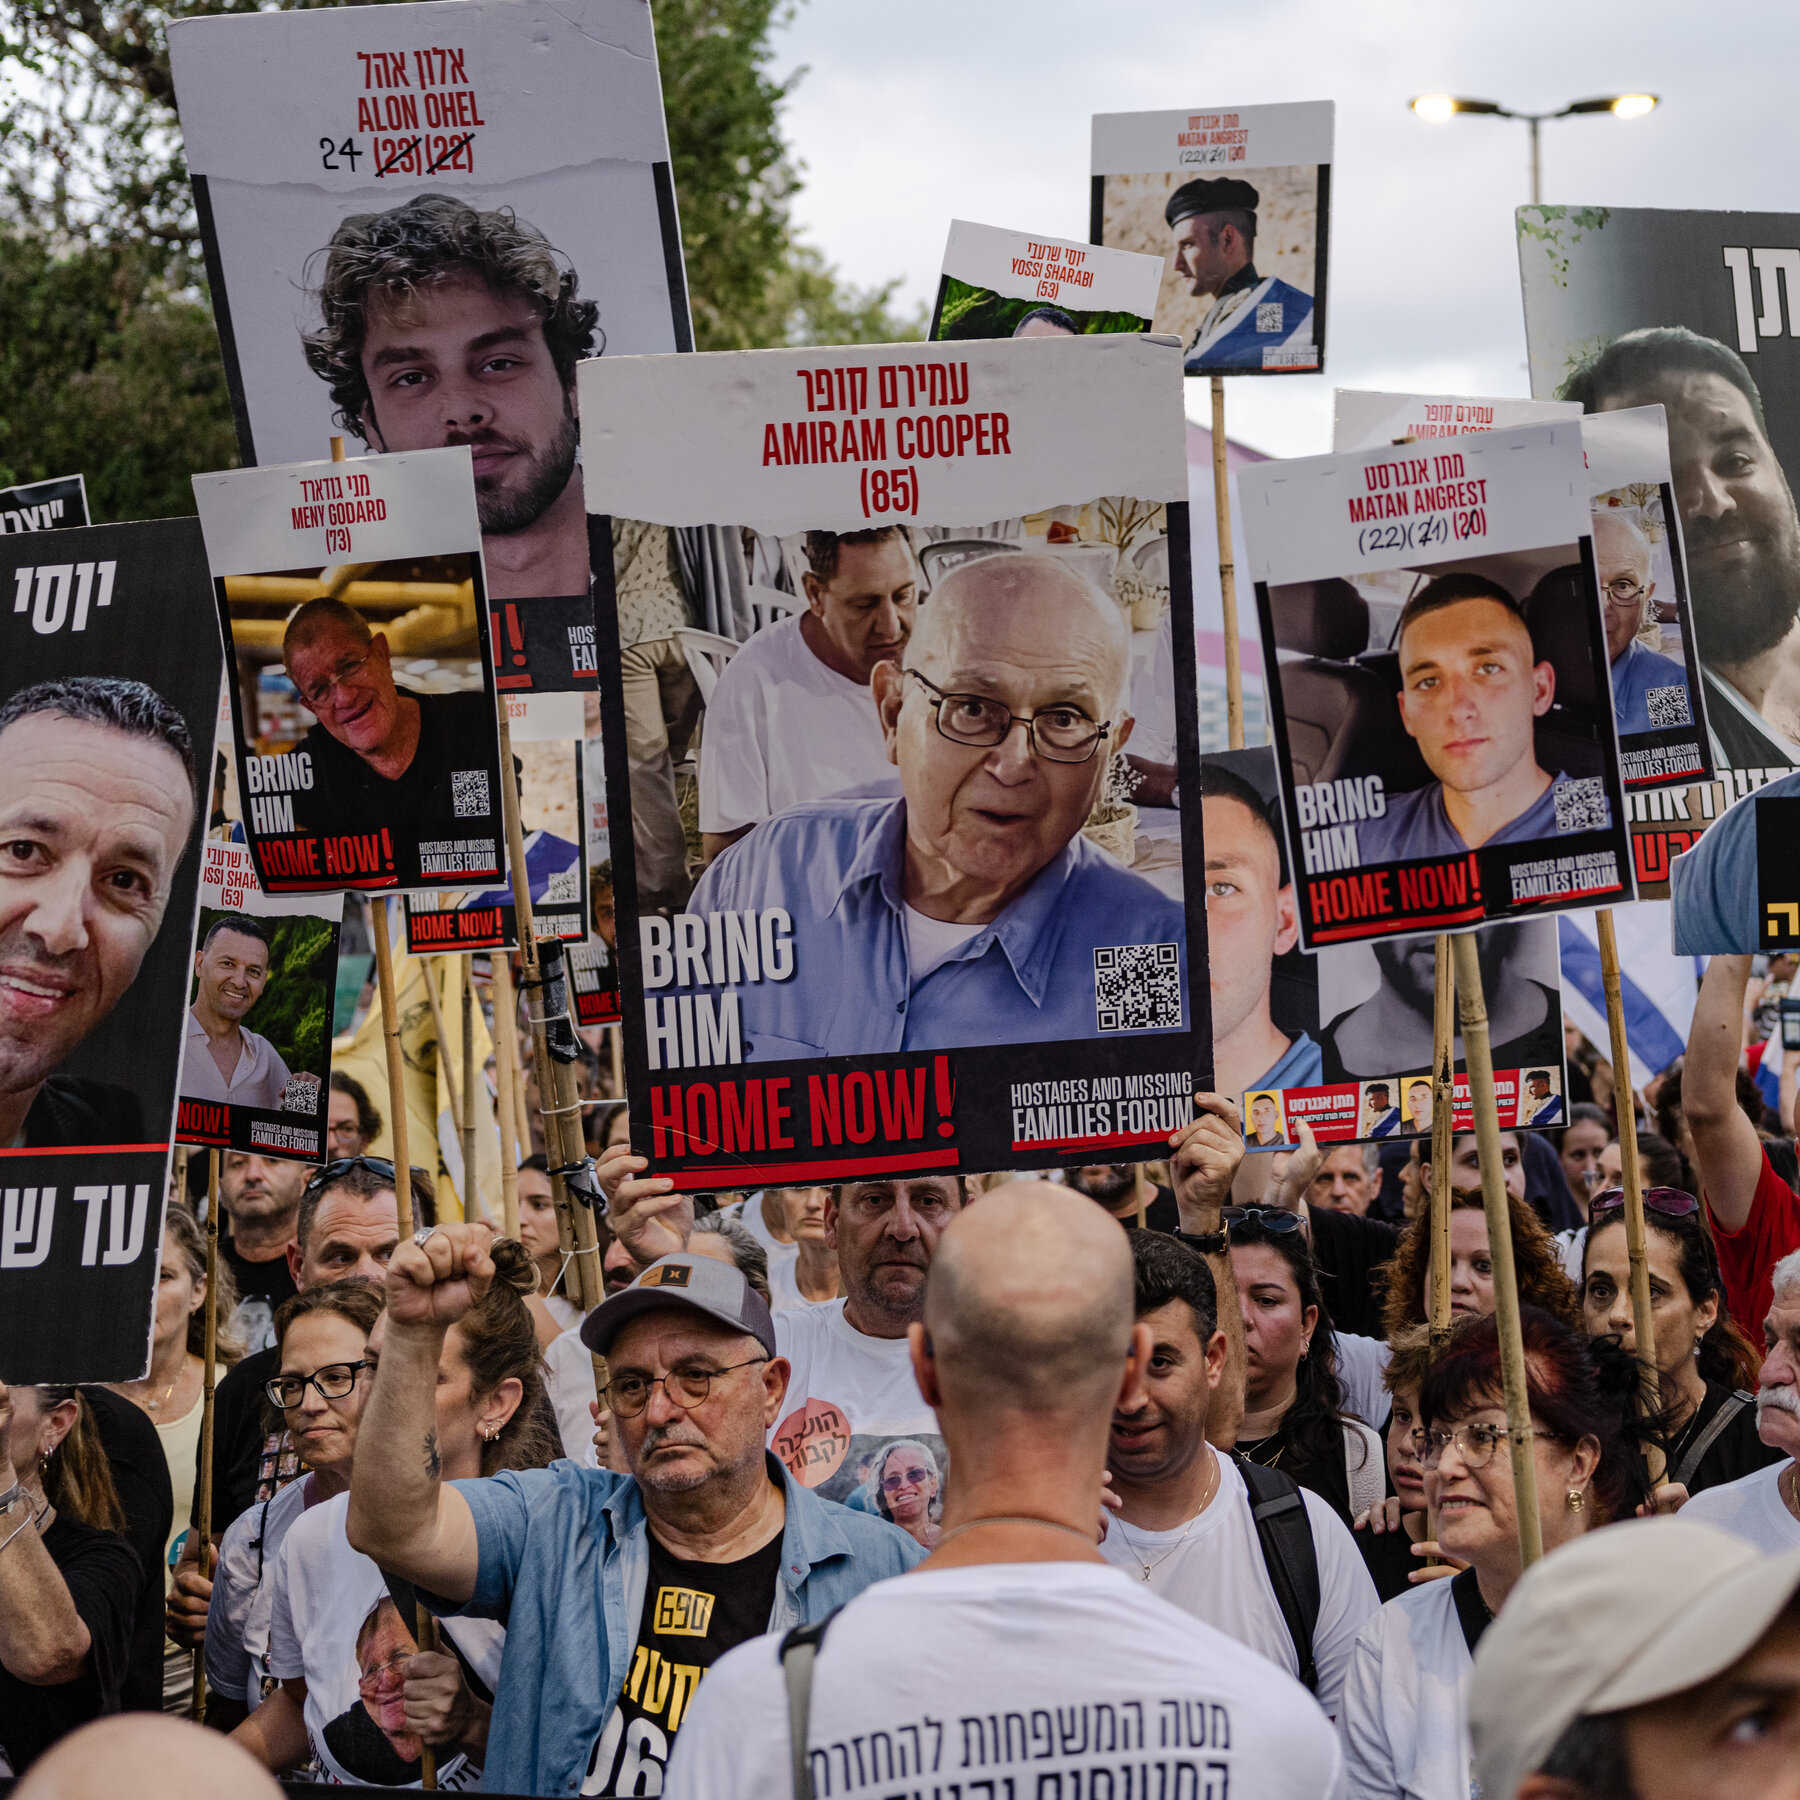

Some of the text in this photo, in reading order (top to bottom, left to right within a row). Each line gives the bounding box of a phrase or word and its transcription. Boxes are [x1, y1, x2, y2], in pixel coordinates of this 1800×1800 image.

[357, 47, 469, 90] אלון אהל
[358, 91, 485, 132] ALON OHEL
[319, 137, 363, 173] 24
[1178, 129, 1248, 147] MATAN ANGREST
[1028, 242, 1086, 267] יוסי שרעבי
[1011, 258, 1094, 288] YOSSI SHARABI
[1036, 280, 1060, 300] (53)
[797, 362, 969, 415] עמירם קופר
[1424, 404, 1493, 424] עמירם קופר
[762, 412, 1012, 467] AMIRAM COOPER
[300, 474, 370, 503] מני גודארד
[1364, 453, 1465, 491] מתן אנגרסט
[860, 465, 919, 518] (85)
[1348, 479, 1487, 523] MATAN ANGREST
[291, 498, 387, 530] MENY GODARD
[326, 527, 352, 555] (73)
[14, 560, 117, 634] יוסי
[1651, 747, 1666, 760] AND
[1666, 742, 1699, 757] MISSING
[1664, 754, 1703, 775] FORUM
[246, 752, 314, 794] BRING
[250, 795, 296, 835] HIM
[1294, 775, 1386, 829] BRING
[207, 847, 242, 868] שרעבי
[257, 838, 322, 877] HOME
[324, 828, 395, 875] NOW!
[418, 838, 496, 855] HOSTAGES AND MISSING
[420, 852, 497, 874] FAMILIES FORUM
[1301, 825, 1361, 876] HIM
[1509, 850, 1617, 879] HOSTAGES AND MISSING
[221, 887, 244, 909] (53)
[1308, 852, 1482, 924] HOME NOW!
[1511, 865, 1620, 900] FAMILIES FORUM
[409, 892, 438, 914] HIM
[411, 907, 503, 941] HOME NOW!
[571, 947, 609, 971] BRING
[638, 907, 794, 989] BRING
[575, 969, 600, 993] HIM
[578, 991, 614, 1016] HOME
[644, 992, 742, 1070] HIM
[650, 1055, 957, 1158] HOME NOW!
[1011, 1071, 1193, 1107] HOSTAGES AND MISSING
[1333, 1094, 1355, 1110] מתן
[177, 1101, 231, 1136] NOW!
[251, 1120, 319, 1140] HOSTAGES AND MISSING
[1012, 1096, 1194, 1143] FAMILIES FORUM
[251, 1130, 318, 1153] FAMILIES FORUM
[0, 1184, 150, 1269] עד ש
[658, 1590, 710, 1631] 690
[960, 1701, 1143, 1768] המשפחות
[1160, 1700, 1230, 1750] מטה
